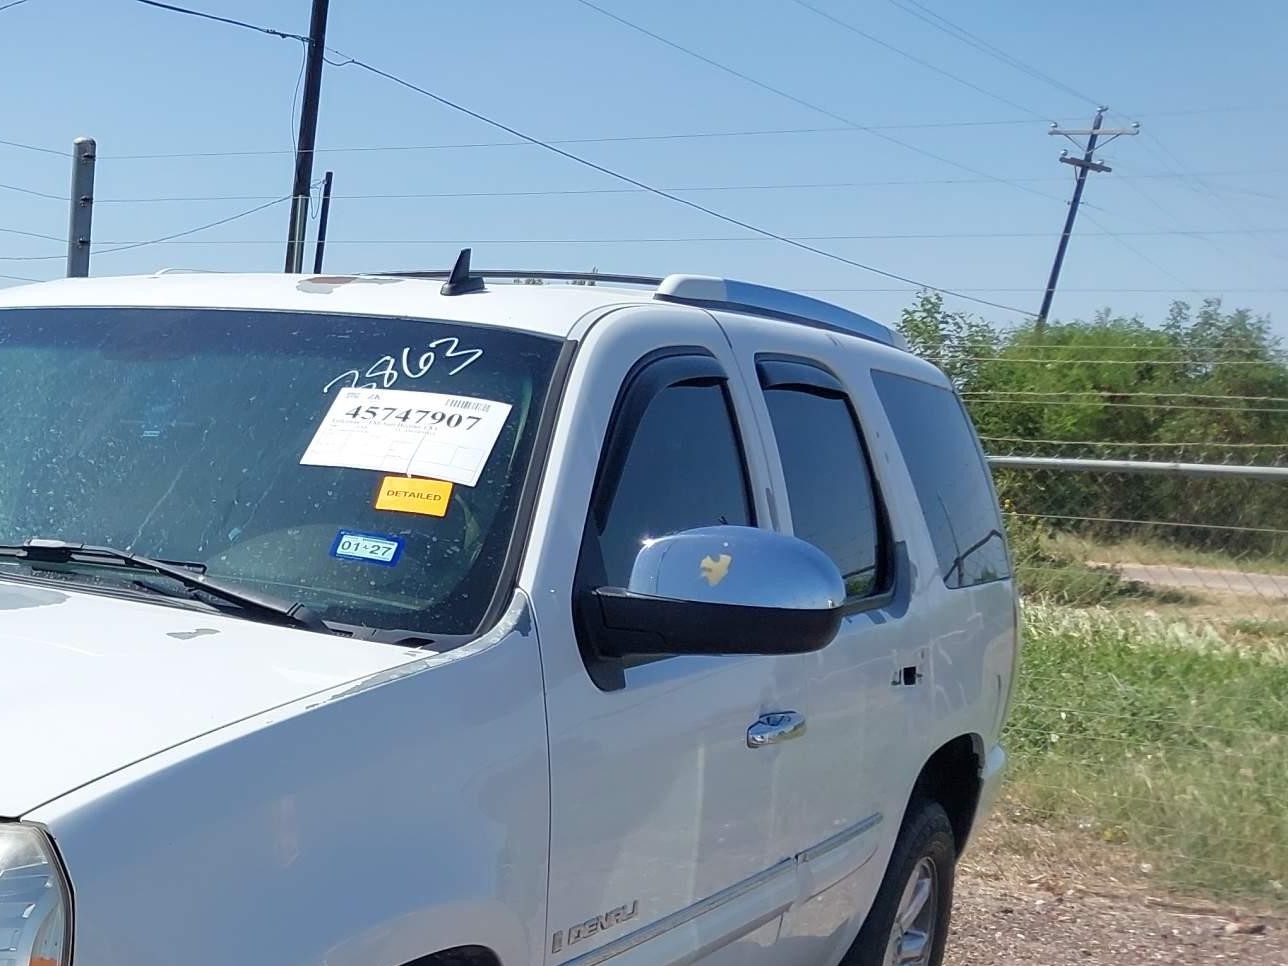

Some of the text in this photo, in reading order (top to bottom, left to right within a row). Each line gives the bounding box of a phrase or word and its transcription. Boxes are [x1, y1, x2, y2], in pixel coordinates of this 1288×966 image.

[344, 405, 482, 431] 45747907
[386, 489, 442, 502] DETAILED
[568, 899, 638, 945] DENALI
